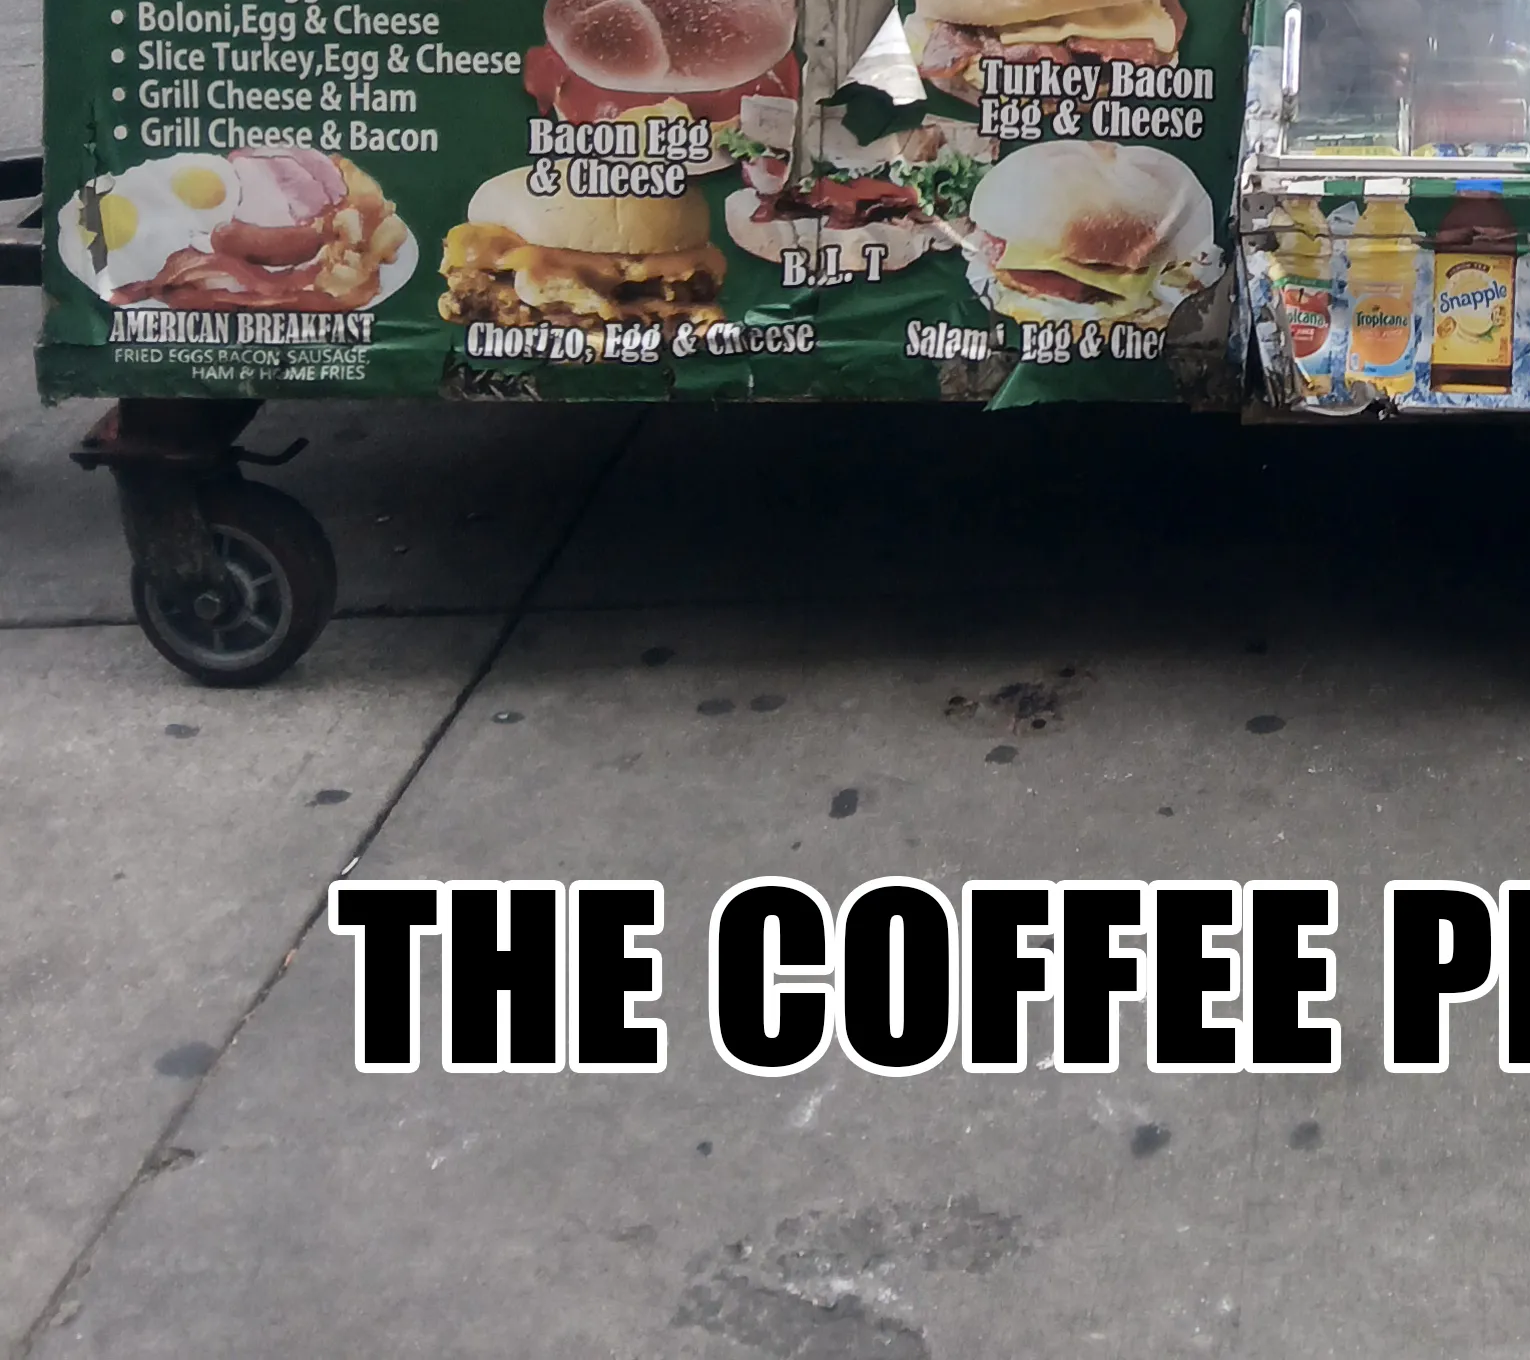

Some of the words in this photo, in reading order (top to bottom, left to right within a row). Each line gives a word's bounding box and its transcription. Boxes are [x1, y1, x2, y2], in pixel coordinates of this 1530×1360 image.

[138, 80, 199, 111] Grill
[207, 81, 312, 113] Cheese
[320, 84, 341, 113] &
[350, 85, 417, 114] Ham
[980, 59, 1101, 102] Turkey
[1110, 62, 1214, 101] Bacon
[980, 99, 1042, 140] Egg
[1053, 104, 1080, 137] &
[1092, 102, 1203, 139] Cheese
[1440, 280, 1507, 313] Snapple
[1356, 311, 1408, 328] Tropicana
